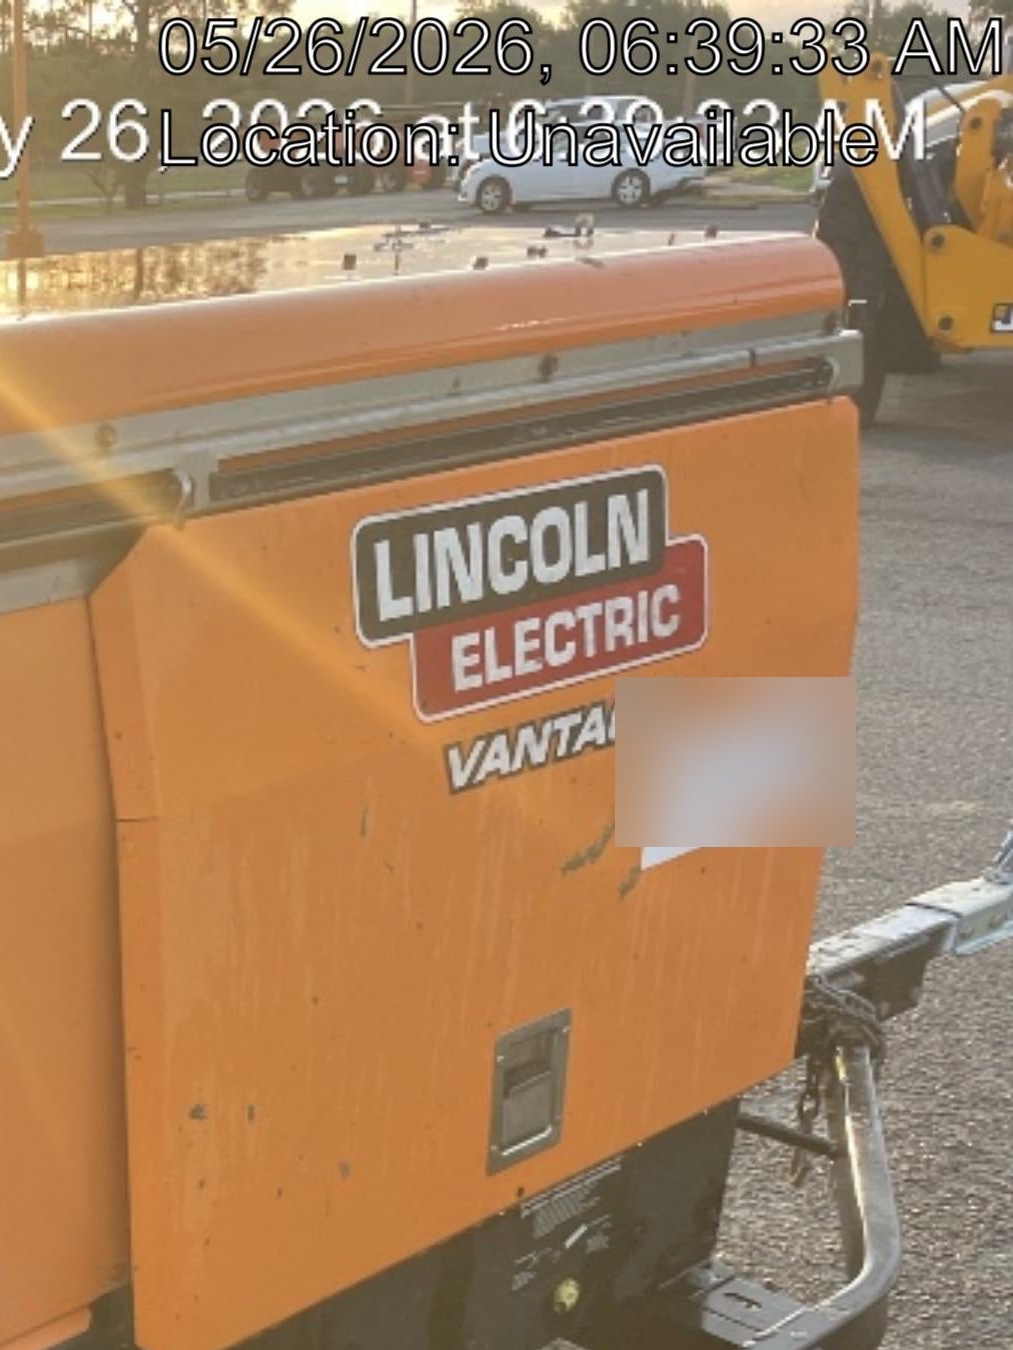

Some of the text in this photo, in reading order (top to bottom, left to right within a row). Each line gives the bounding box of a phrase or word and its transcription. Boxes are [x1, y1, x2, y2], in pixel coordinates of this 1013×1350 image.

[374, 488, 651, 622] LINCOLN
[450, 583, 680, 692] ELECTRIC
[446, 700, 615, 793] VANTA
